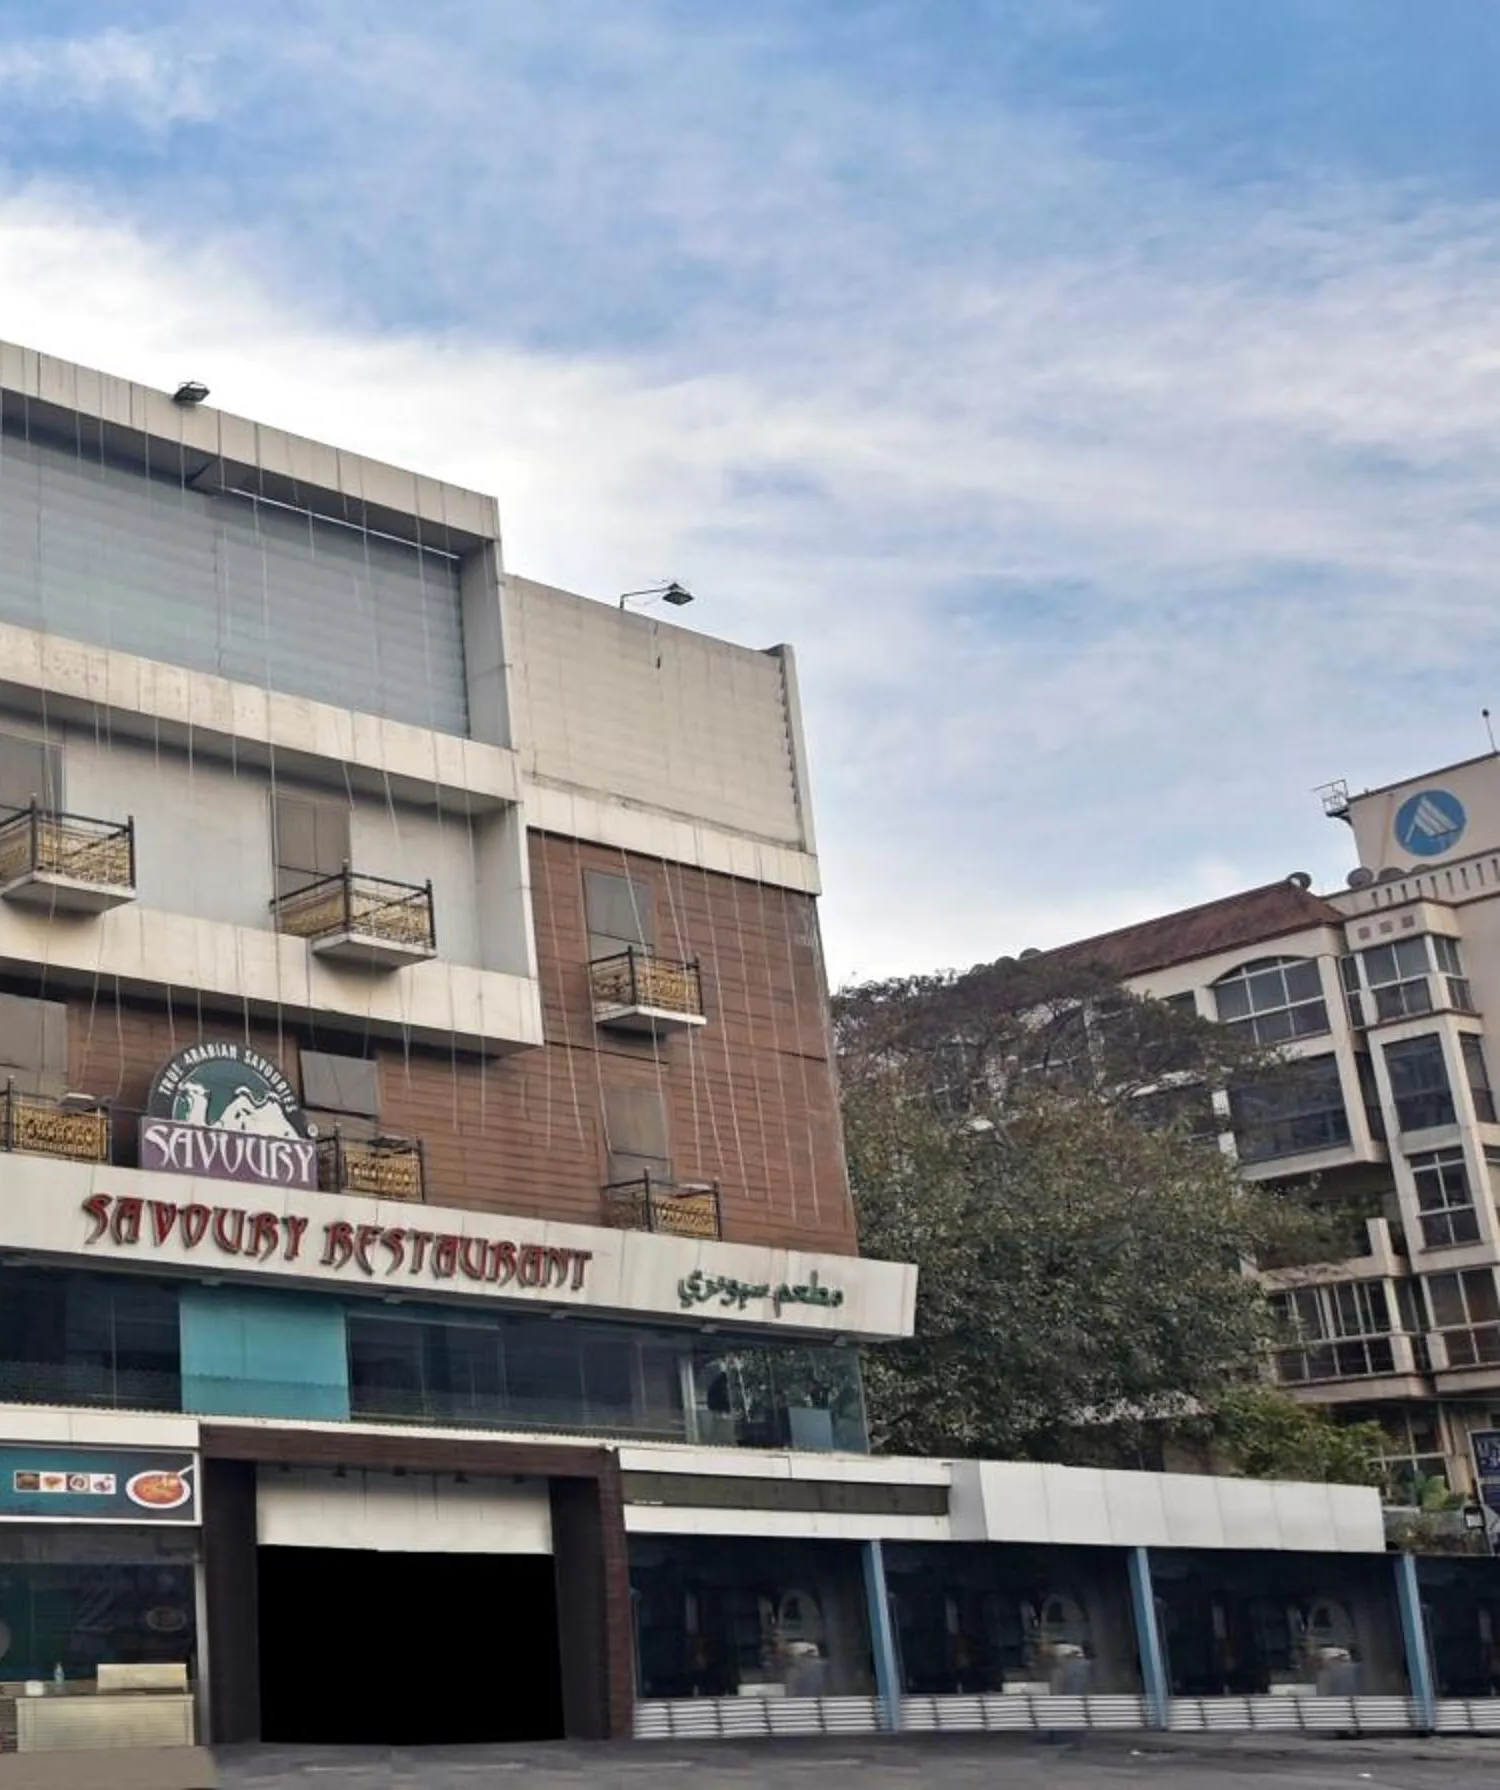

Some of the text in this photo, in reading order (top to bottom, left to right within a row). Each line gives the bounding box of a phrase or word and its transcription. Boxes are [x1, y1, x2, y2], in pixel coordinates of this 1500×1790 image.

[158, 1043, 298, 1113] TRUE ARABIAN SAVOURIES
[145, 1125, 313, 1183] SAVOURY
[82, 1194, 592, 1291] SAVOURY RESTAURANT
